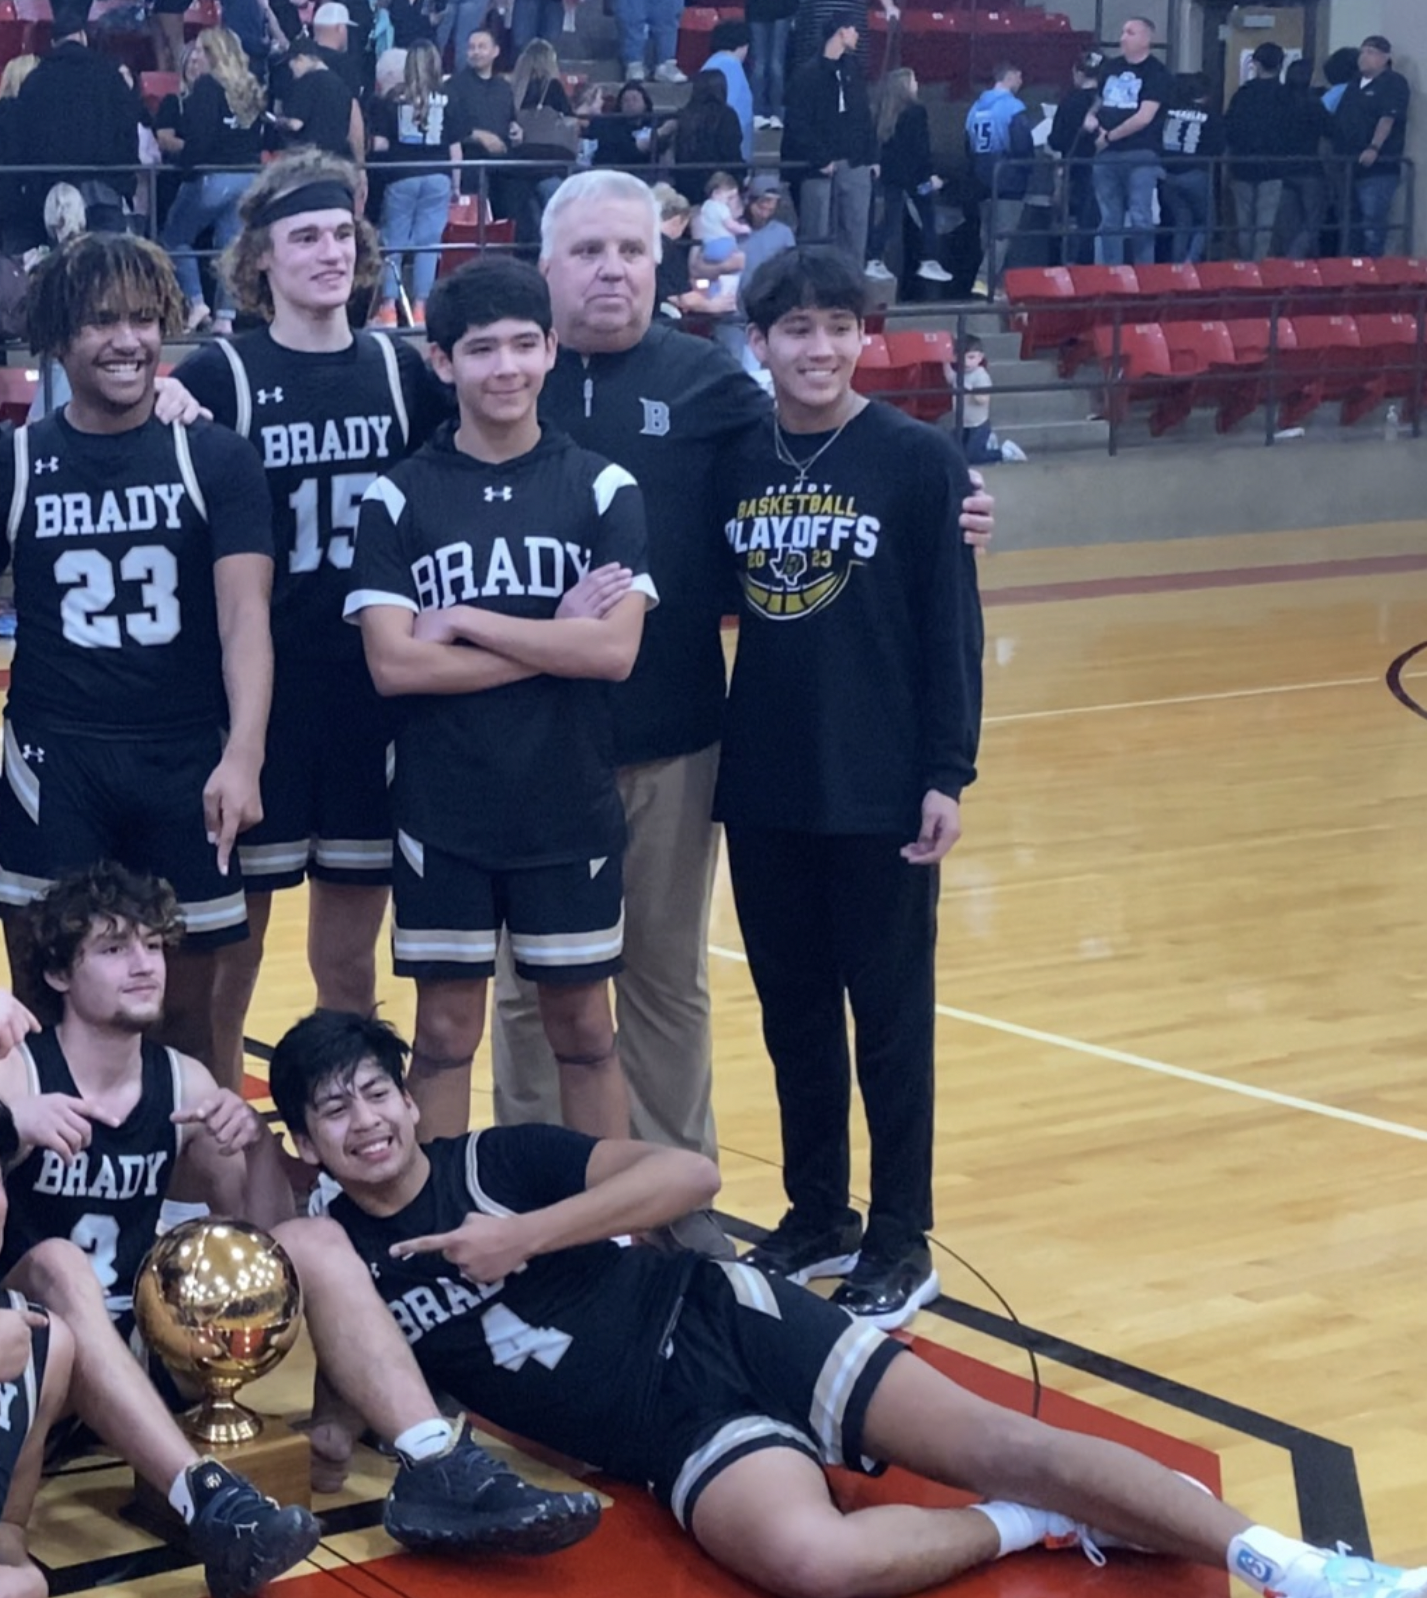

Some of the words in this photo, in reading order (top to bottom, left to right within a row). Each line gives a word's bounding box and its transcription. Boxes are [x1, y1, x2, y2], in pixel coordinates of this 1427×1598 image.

[261, 415, 392, 468] BRADY
[639, 397, 670, 436] B
[34, 483, 185, 538] BRADY
[288, 472, 377, 573] 15
[737, 494, 858, 519] BASKETBALL
[724, 515, 880, 558] PLAYOFFS
[747, 550, 766, 569] 20
[811, 550, 833, 568] 23
[53, 545, 182, 648] 23
[411, 537, 591, 612] BRADY
[33, 1149, 168, 1199] BRADY
